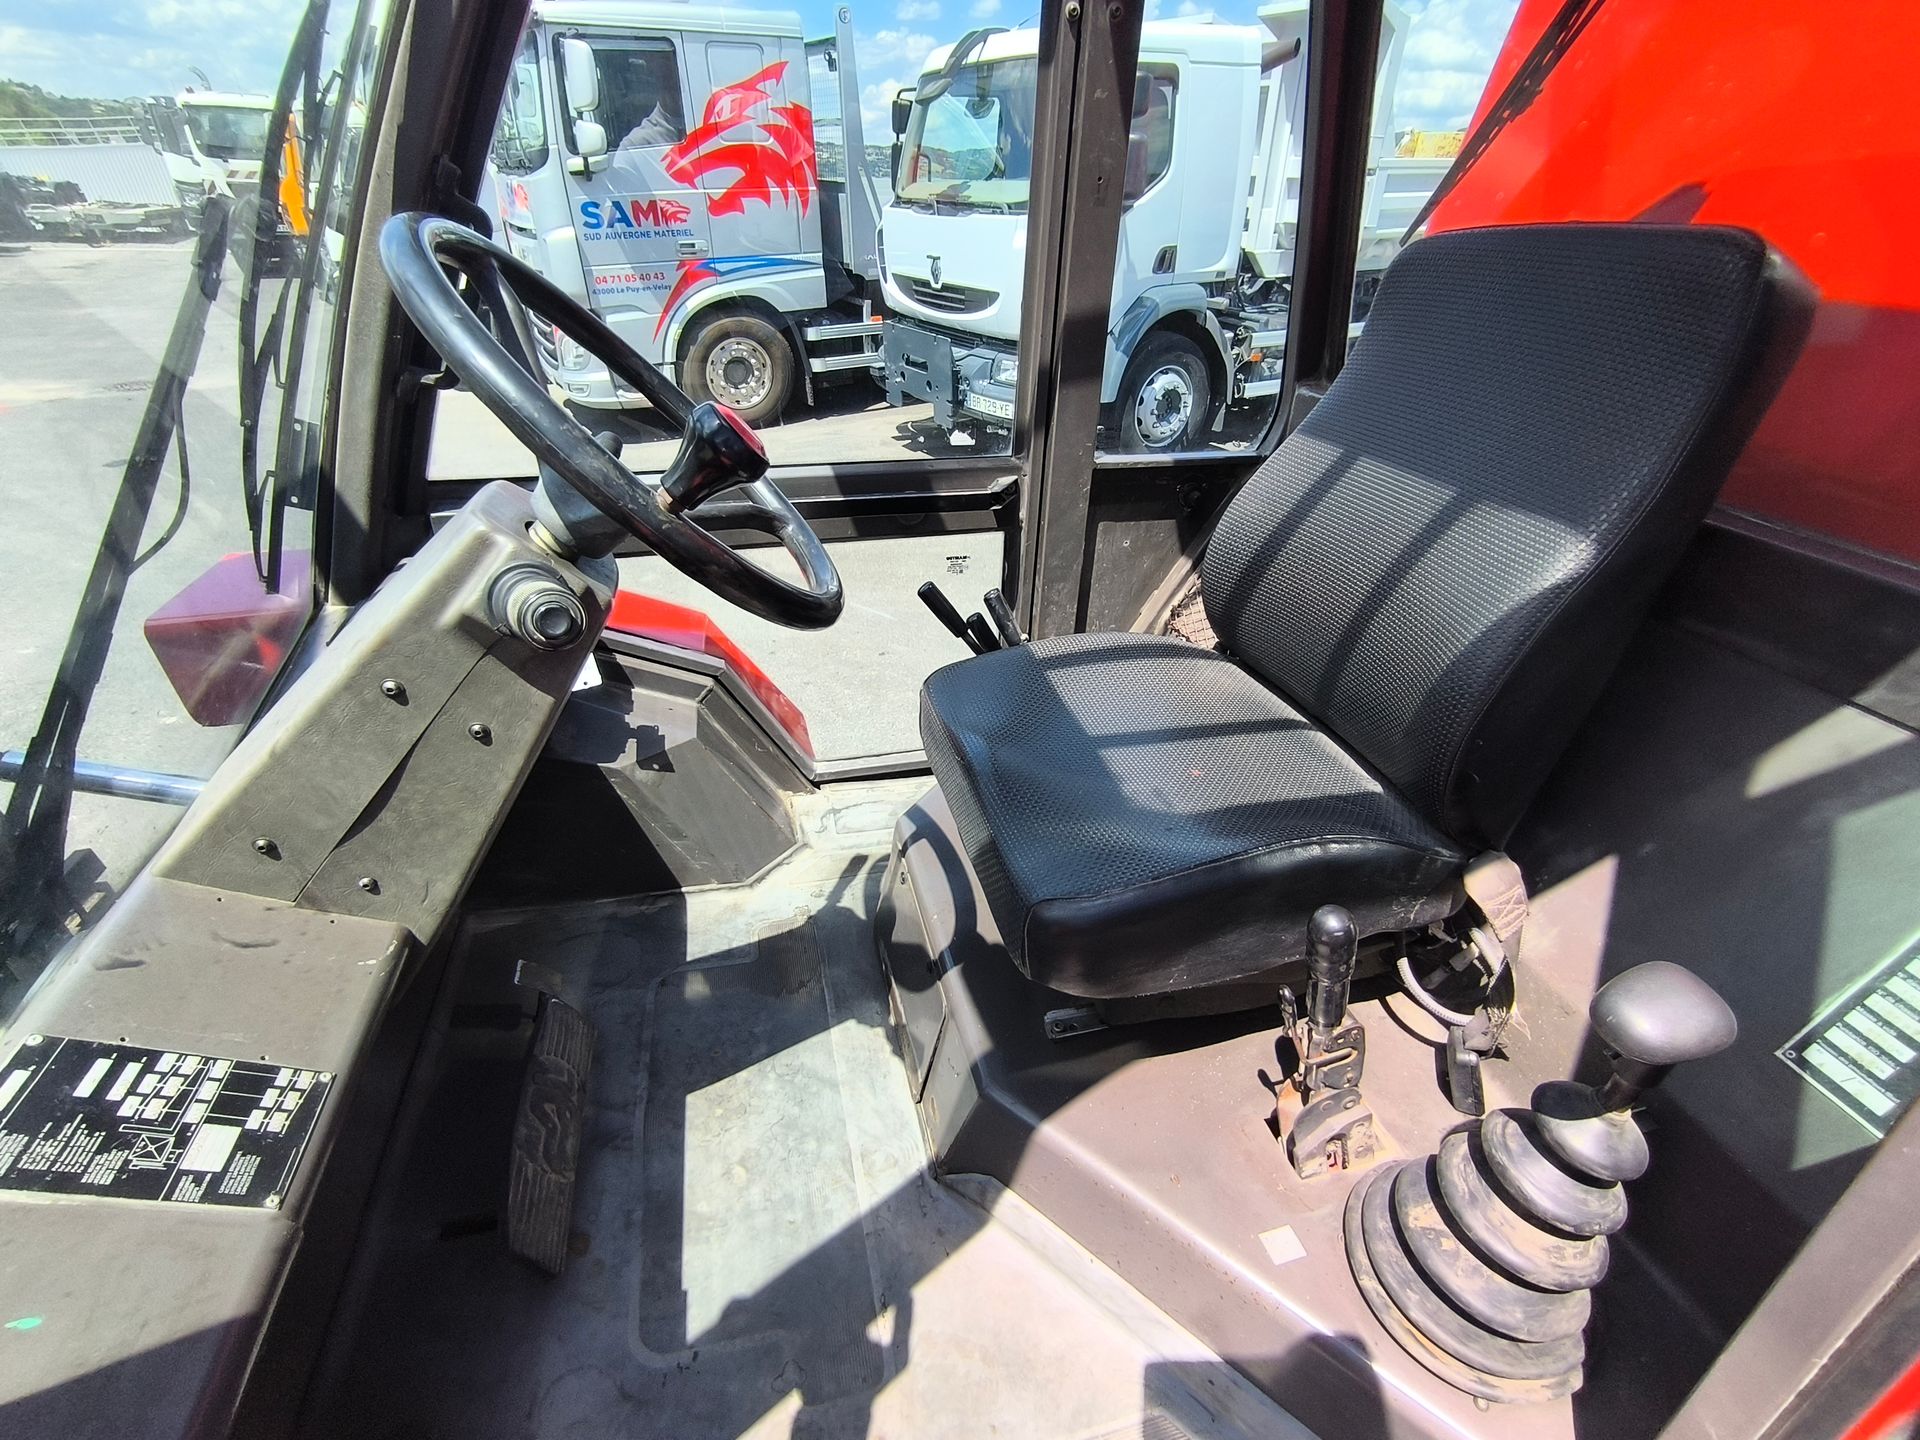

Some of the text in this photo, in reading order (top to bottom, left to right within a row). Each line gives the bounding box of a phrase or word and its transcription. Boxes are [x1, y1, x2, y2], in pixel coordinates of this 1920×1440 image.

[580, 200, 661, 229] SAM
[584, 229, 694, 241] SUD AUVERGNE MATERIEL
[595, 271, 666, 285] 04 71 05 40 43
[592, 287, 615, 296] 43000
[616, 286, 625, 294] Le
